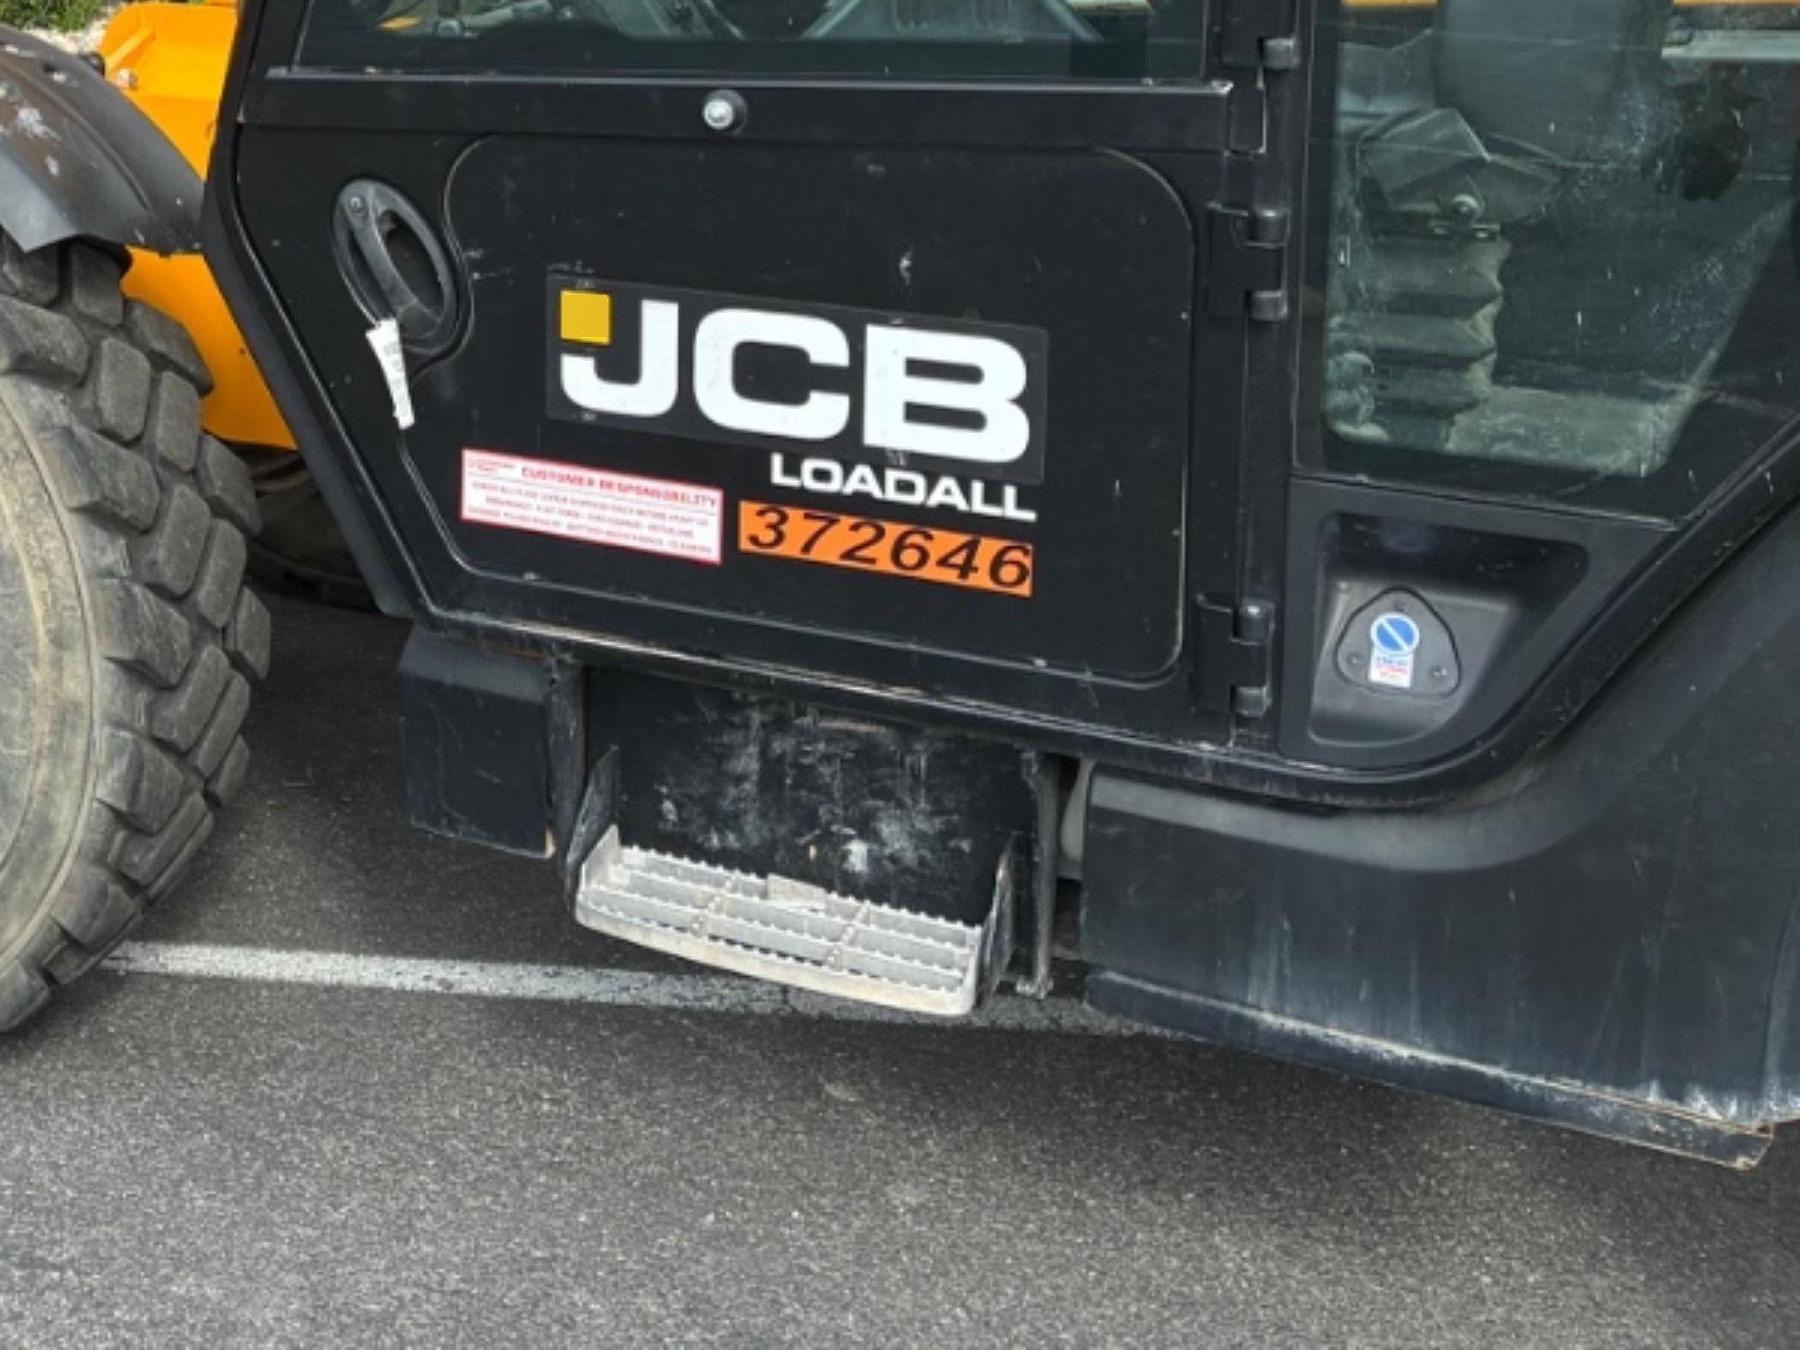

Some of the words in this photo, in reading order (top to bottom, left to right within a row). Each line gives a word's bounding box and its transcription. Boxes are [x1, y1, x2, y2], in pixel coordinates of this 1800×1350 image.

[560, 291, 1030, 463] JCB
[521, 466, 595, 487] CUSTOMER
[771, 453, 1037, 521] LOADALL
[748, 506, 1030, 590] 372646
